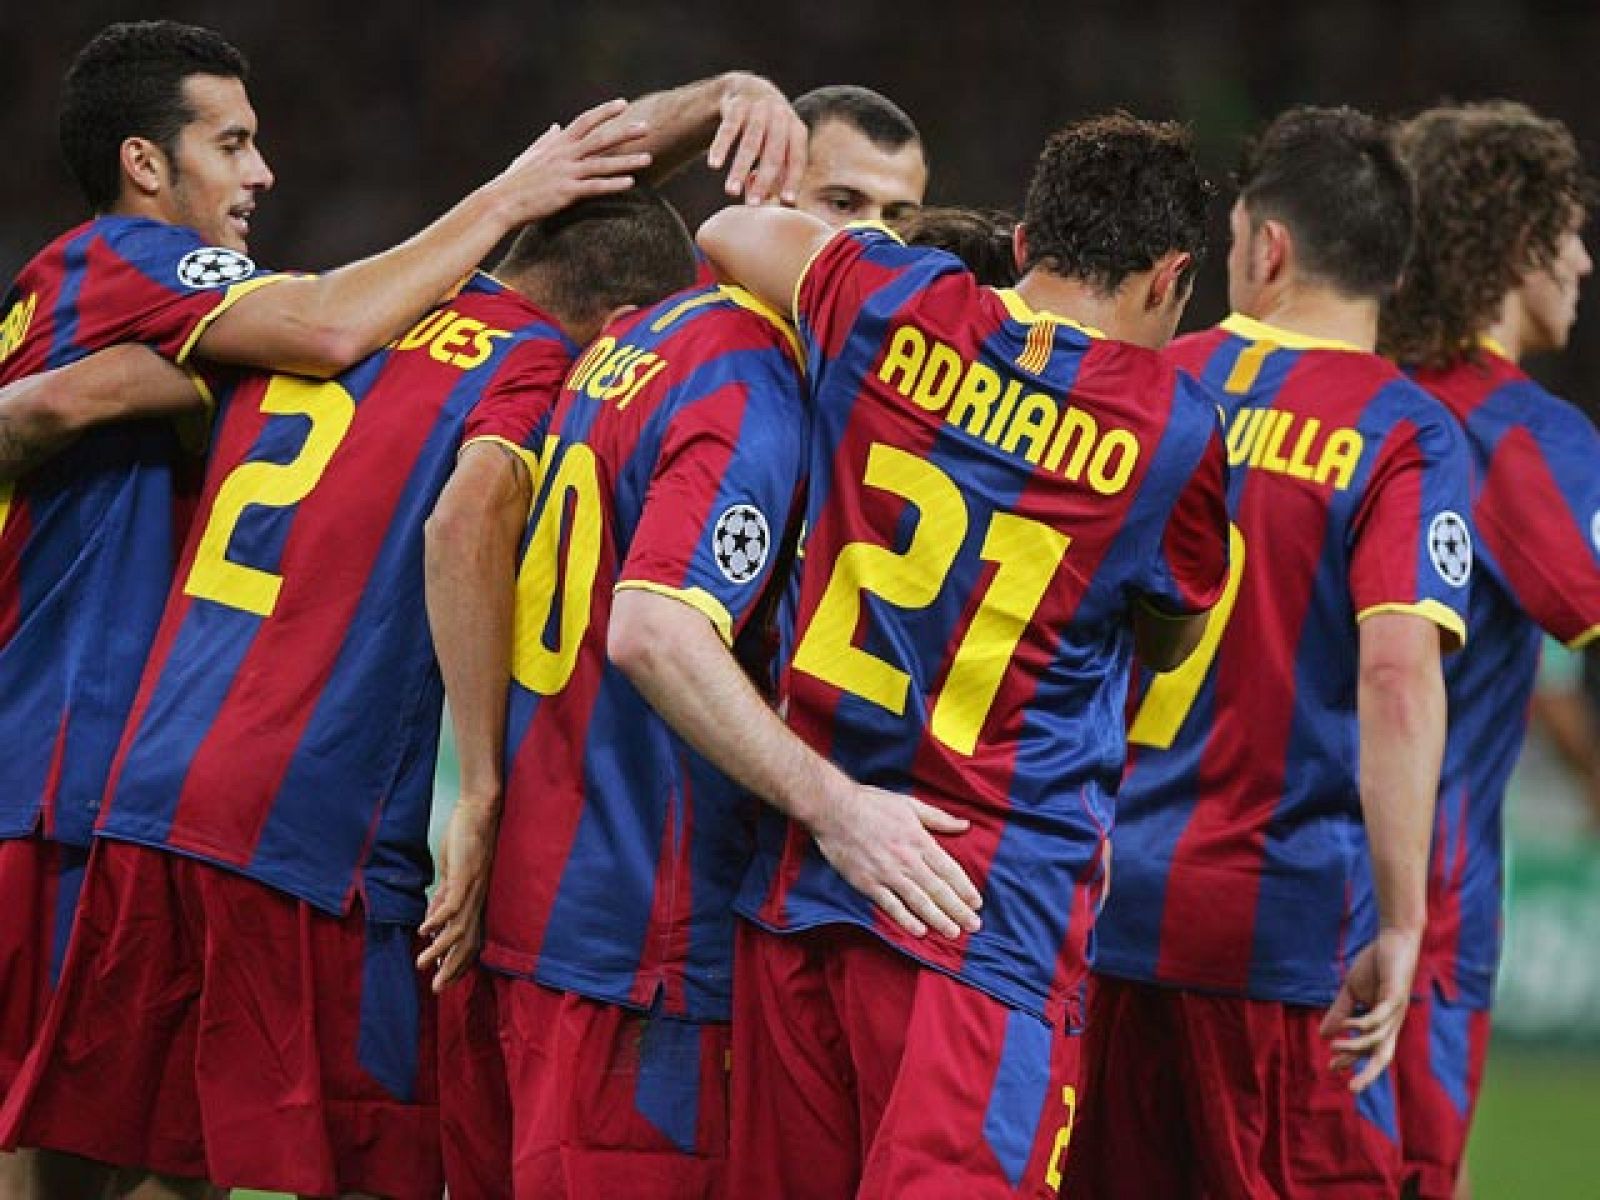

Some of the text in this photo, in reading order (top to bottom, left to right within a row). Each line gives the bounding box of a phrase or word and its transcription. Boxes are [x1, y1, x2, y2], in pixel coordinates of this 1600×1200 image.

[183, 375, 355, 617] 2
[878, 325, 1140, 495] ADRIANO
[1226, 408, 1364, 491] VILLA
[791, 441, 1073, 757] 21
